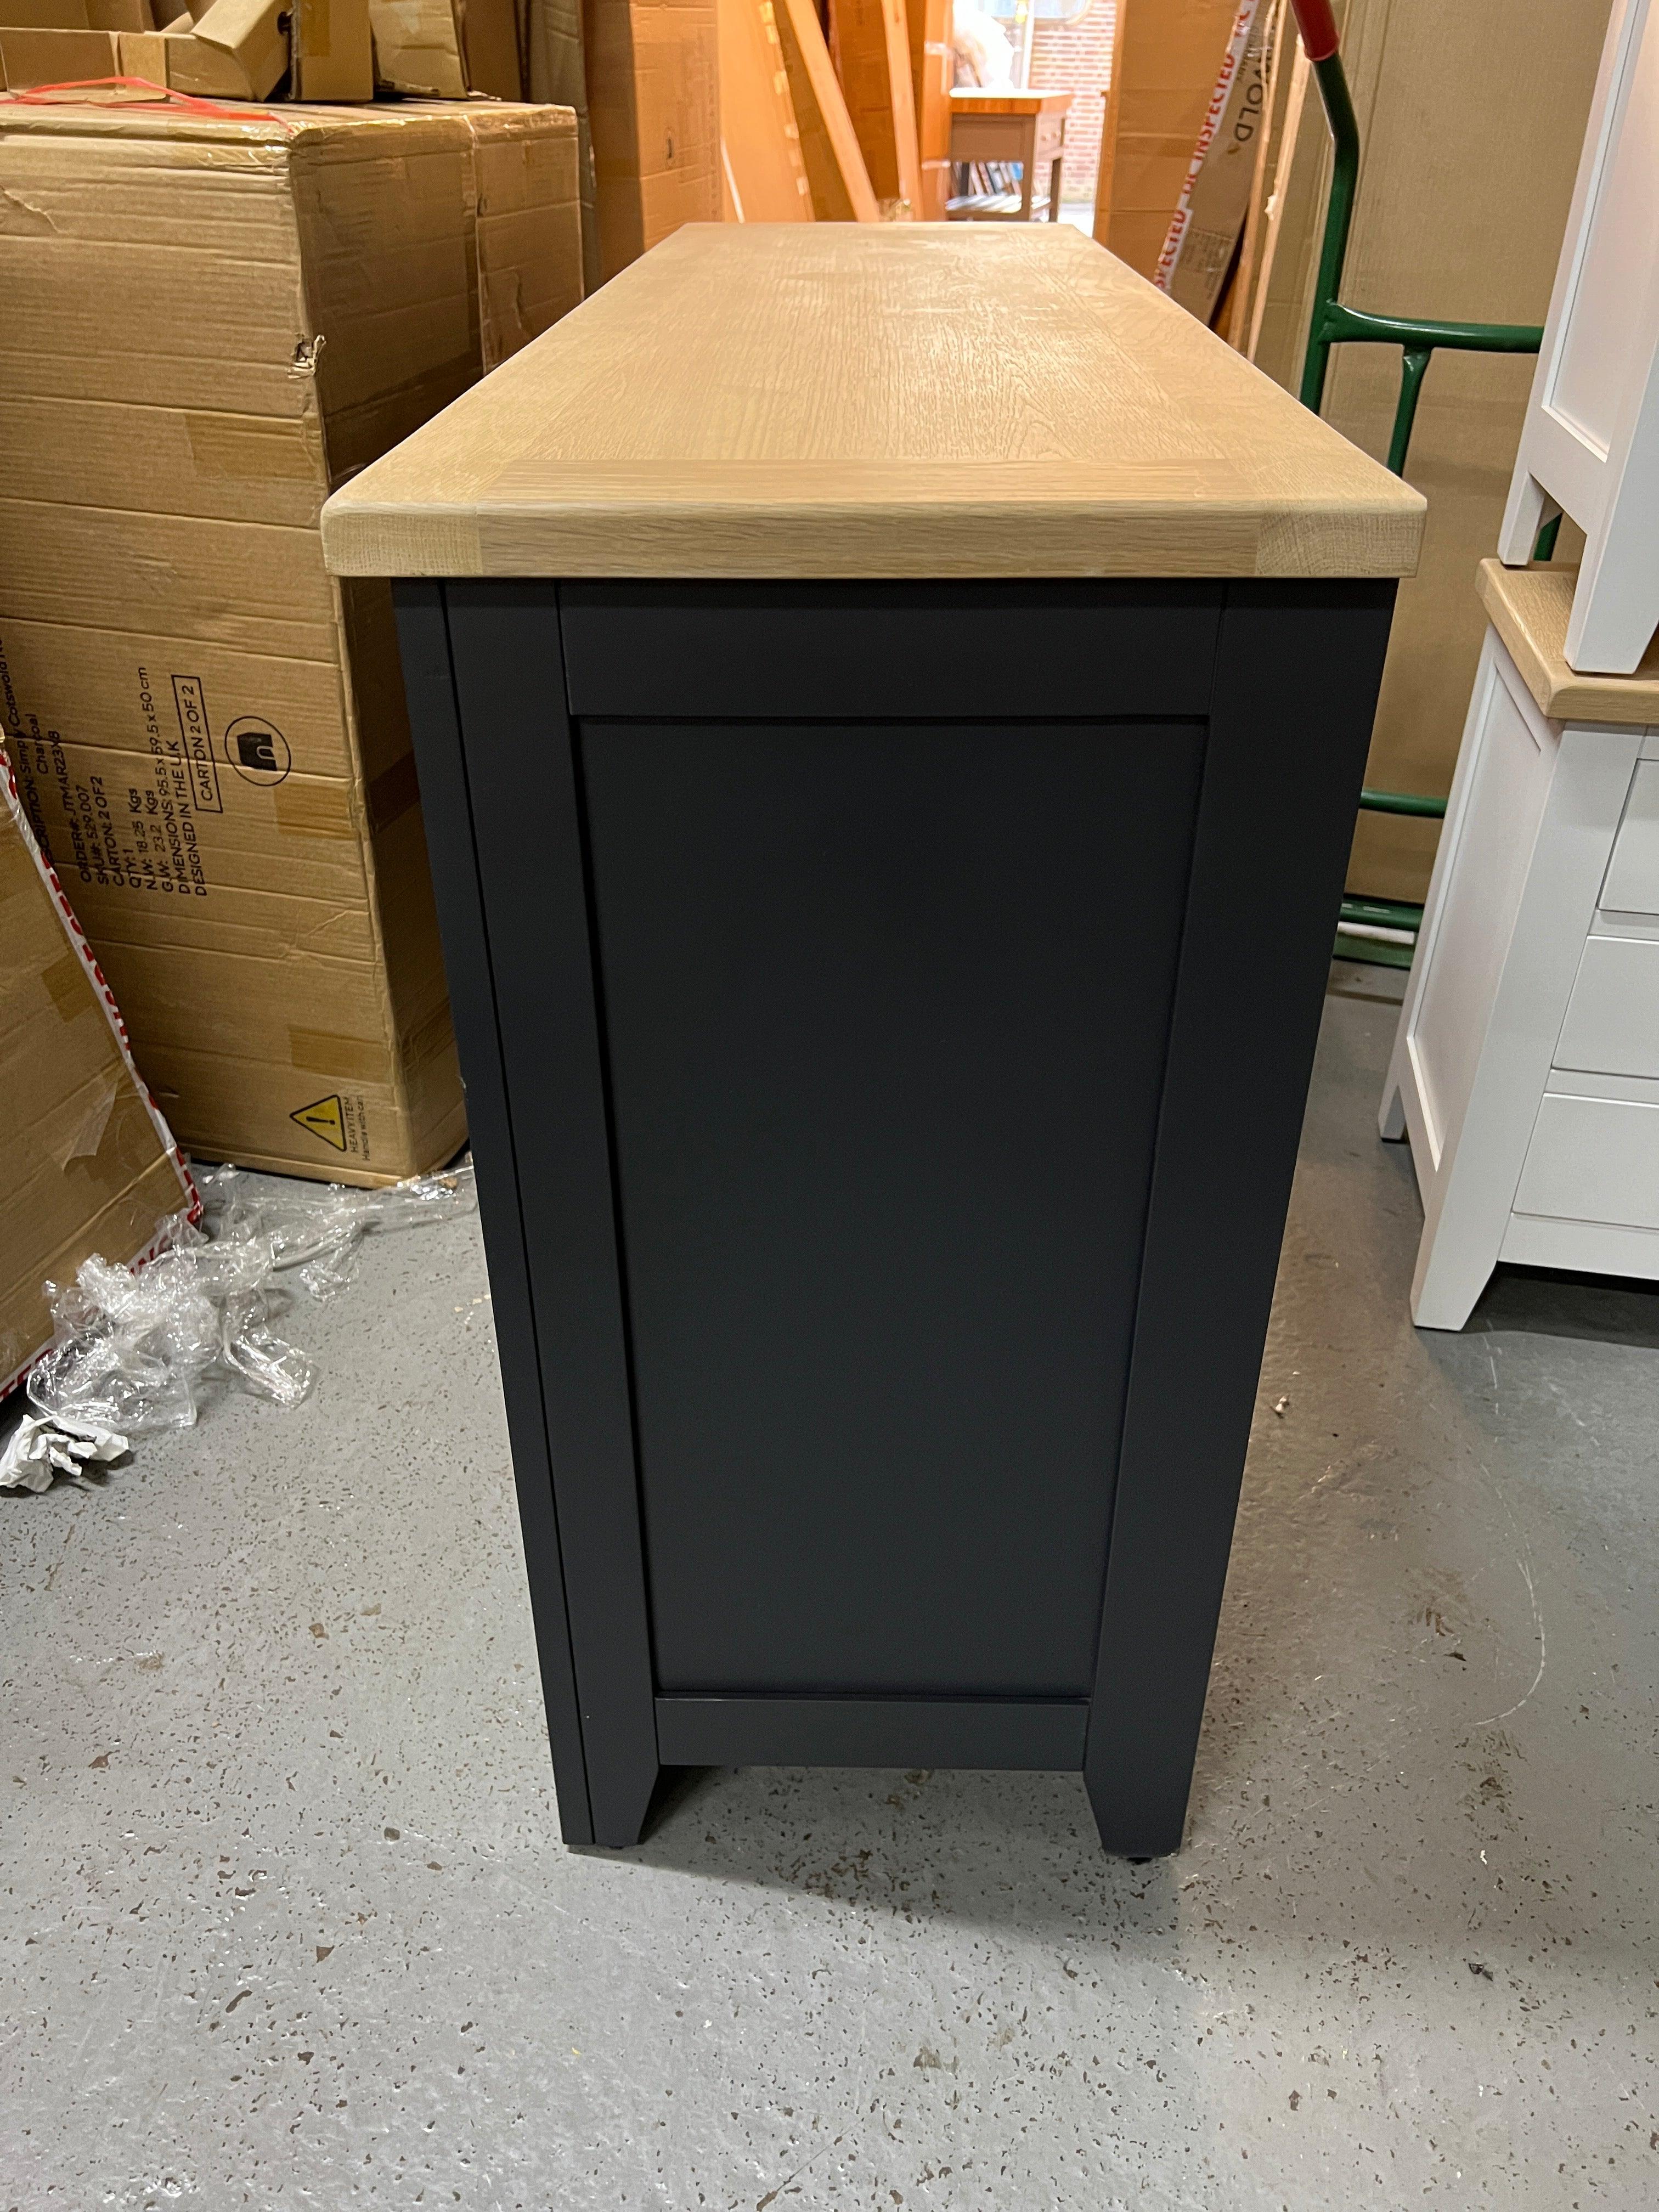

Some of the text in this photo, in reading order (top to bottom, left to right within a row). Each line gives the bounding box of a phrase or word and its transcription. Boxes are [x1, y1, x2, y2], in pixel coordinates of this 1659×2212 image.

[138, 667, 149, 690] cm
[140, 692, 154, 712] 50
[147, 724, 163, 755] 59.5
[182, 685, 212, 801] CARTON 2 OF 2
[155, 767, 170, 797] 95.5
[172, 770, 187, 798] THE
[76, 785, 98, 839] 529.007
[128, 788, 142, 813] Kgs
[145, 790, 158, 815] Kgs
[178, 803, 191, 818] IN
[91, 776, 125, 887] CARTON: 2 OF 2
[124, 856, 142, 888] QTY:
[182, 822, 207, 896] DESIGNED
